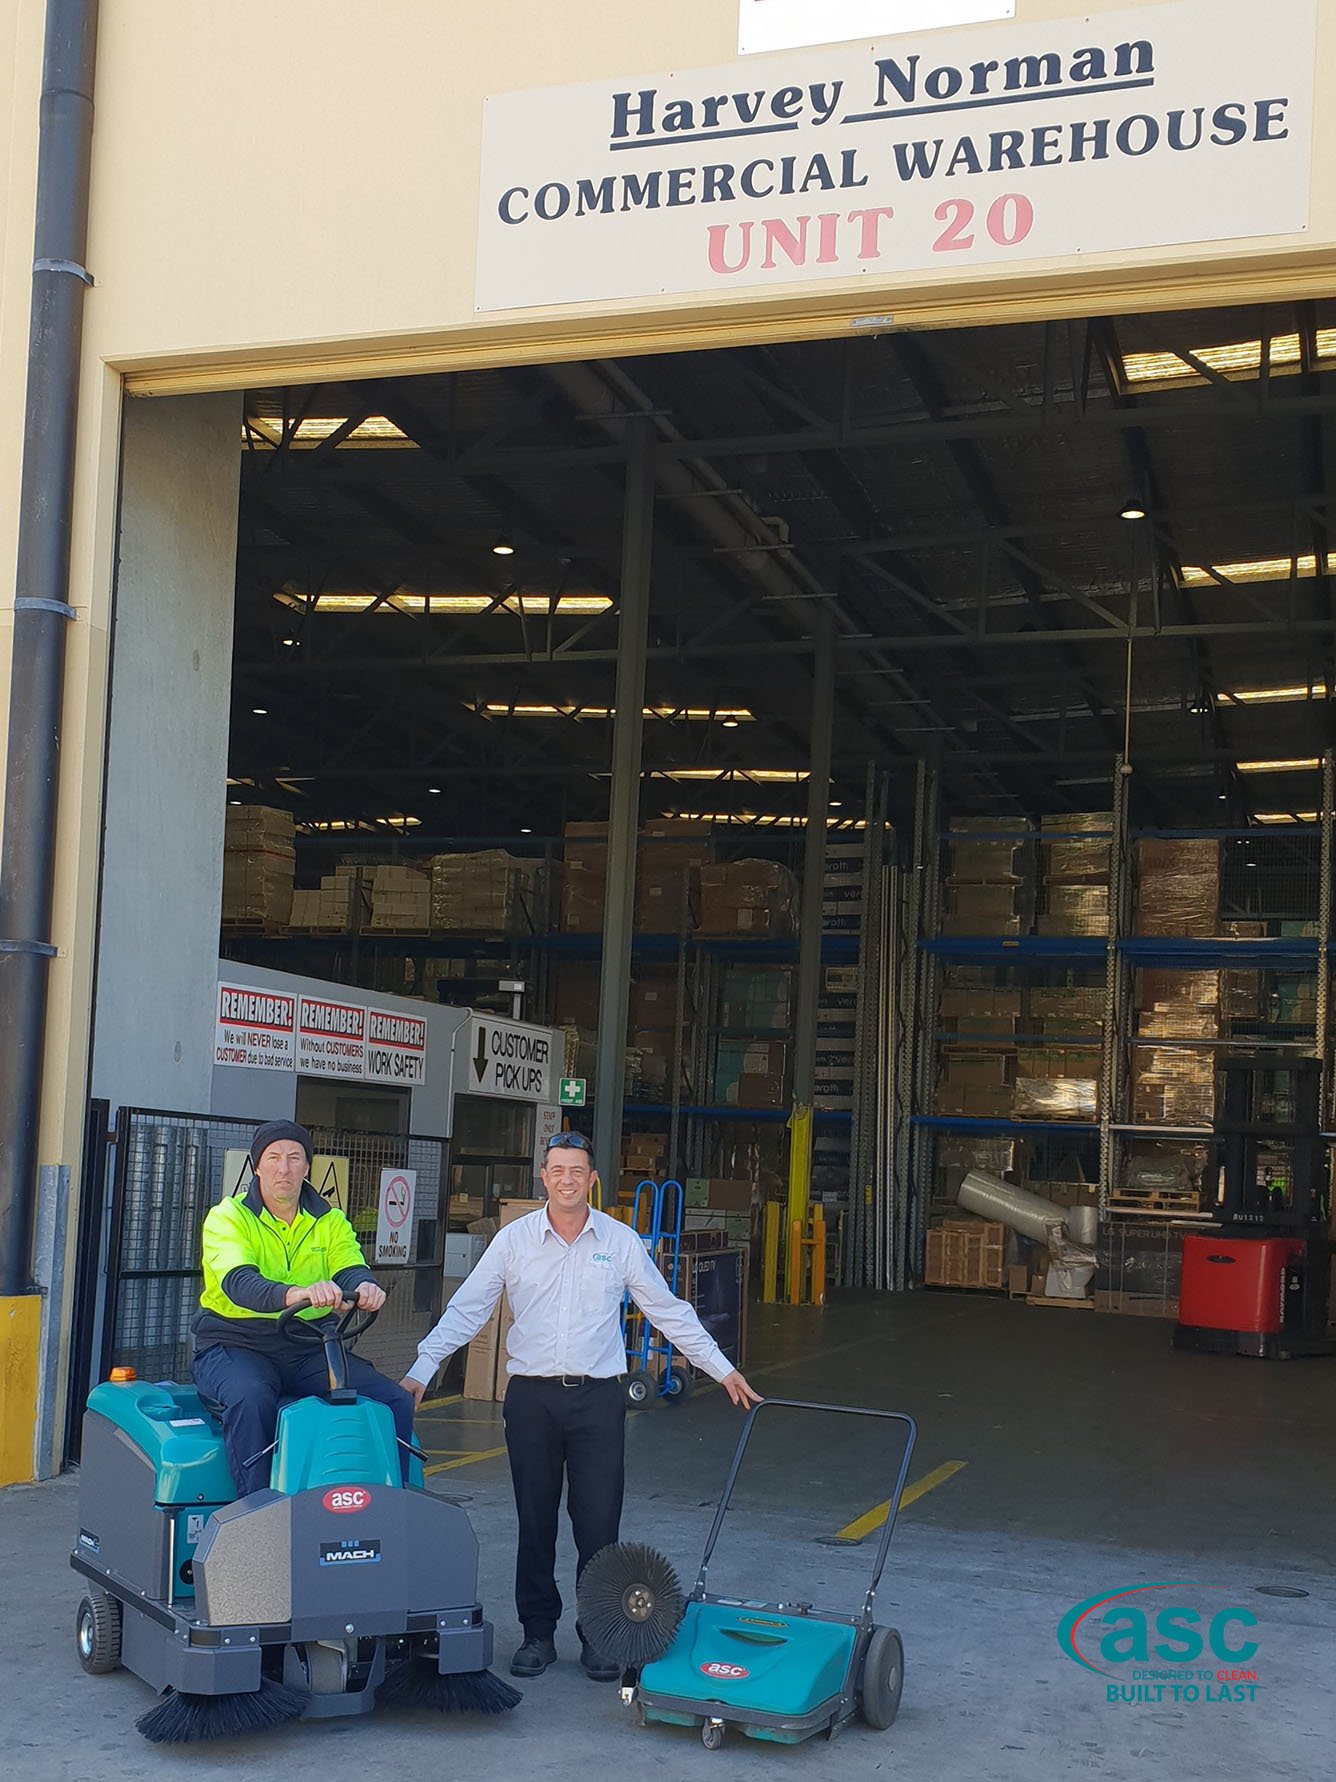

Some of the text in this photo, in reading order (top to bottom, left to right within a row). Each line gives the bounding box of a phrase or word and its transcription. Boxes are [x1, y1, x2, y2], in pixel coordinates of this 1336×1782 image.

[610, 40, 1155, 139] Harvey Norman
[498, 97, 1290, 225] COMMERCIAL WAREHOUSE
[706, 193, 1035, 274] UNIT 20
[222, 990, 292, 1027] REMEMBER!
[302, 1003, 363, 1036] REMEMBER!
[224, 1030, 289, 1050] We will NEVER lose a
[370, 1014, 424, 1046] REMEMBER!
[216, 1046, 293, 1068] CUSTOMER due to bad service
[300, 1038, 363, 1058] Without CUSTOMERS
[491, 1030, 549, 1064] CUSTOMER
[300, 1056, 362, 1074] we have no business
[368, 1050, 423, 1079] WORK SAFETY
[495, 1062, 542, 1093] PICK UPS
[389, 1231, 398, 1244] NO
[378, 1245, 407, 1258] SMOKING
[332, 1491, 364, 1506] asc
[326, 1550, 374, 1560] MACH
[708, 1663, 743, 1676] asc
